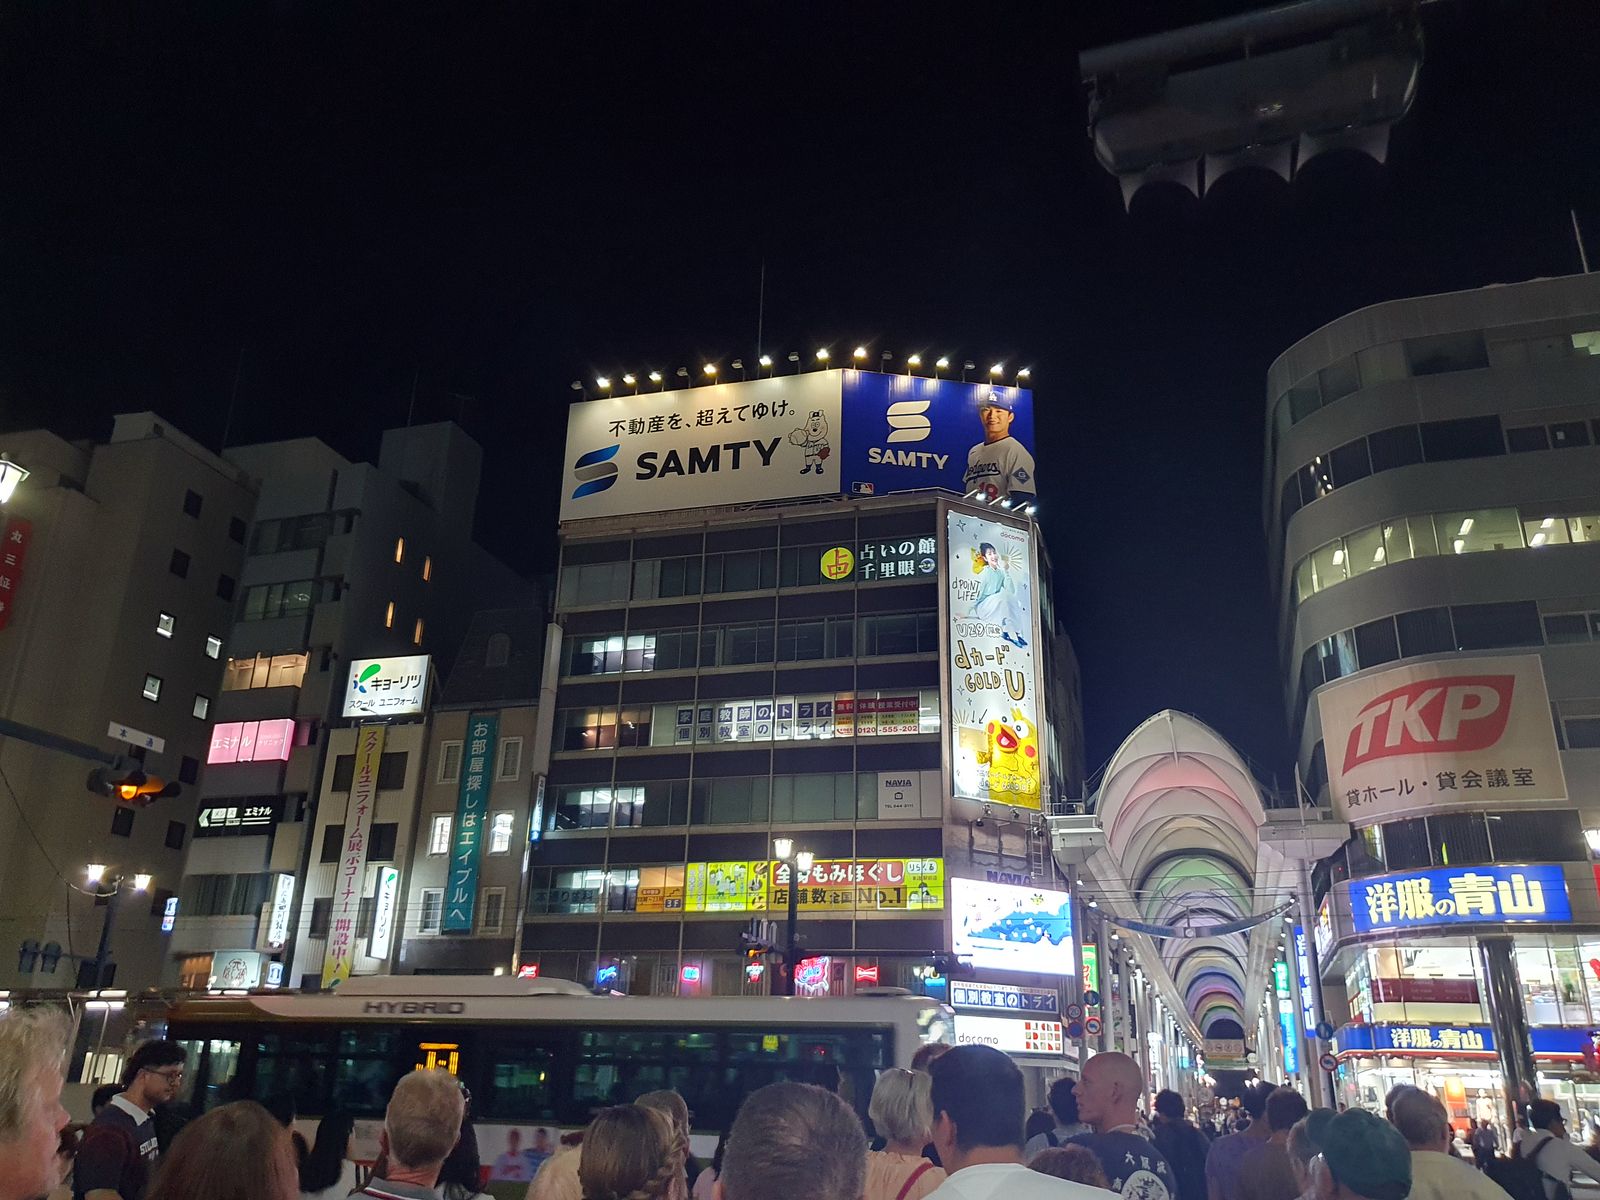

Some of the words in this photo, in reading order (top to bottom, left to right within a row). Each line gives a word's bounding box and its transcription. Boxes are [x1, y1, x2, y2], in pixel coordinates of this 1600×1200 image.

[608, 400, 795, 437] 不動産を、超えてゆけ。
[635, 437, 782, 480] SAMTY
[868, 448, 949, 470] SAMTY
[1000, 531, 1025, 542] docomo
[860, 538, 936, 560] 占いの館
[827, 549, 849, 577] 占
[860, 560, 914, 579] 千里眼
[957, 590, 980, 601] LIFE!
[956, 623, 985, 637] U29
[955, 640, 1010, 669] dカード
[371, 675, 422, 691] キョーリツ
[965, 671, 1001, 692] GOLD
[1004, 669, 1025, 701] U
[349, 700, 375, 708] スクール
[379, 696, 418, 706] ユニフォーム
[679, 703, 832, 725] 家庭教師のトライ
[1355, 684, 1500, 757] TKP
[679, 720, 829, 739] 個別教室のトライ
[857, 725, 918, 734] 0120-555-202
[213, 736, 252, 749] エミナル
[1347, 768, 1536, 809] 貸ホール・貸会議室
[244, 807, 272, 816] エミナル
[450, 722, 488, 921] お部屋探しはエイブルへ
[340, 731, 377, 913] スクールユニフォーム展示コーナー
[987, 871, 1031, 886] NAVIA
[858, 888, 900, 904] No.1
[1365, 873, 1546, 924] 洋服の青山
[954, 989, 1057, 1009] 個別教室のトライ
[958, 1033, 999, 1044] docomo
[1391, 1029, 1483, 1049] 洋服の青山
